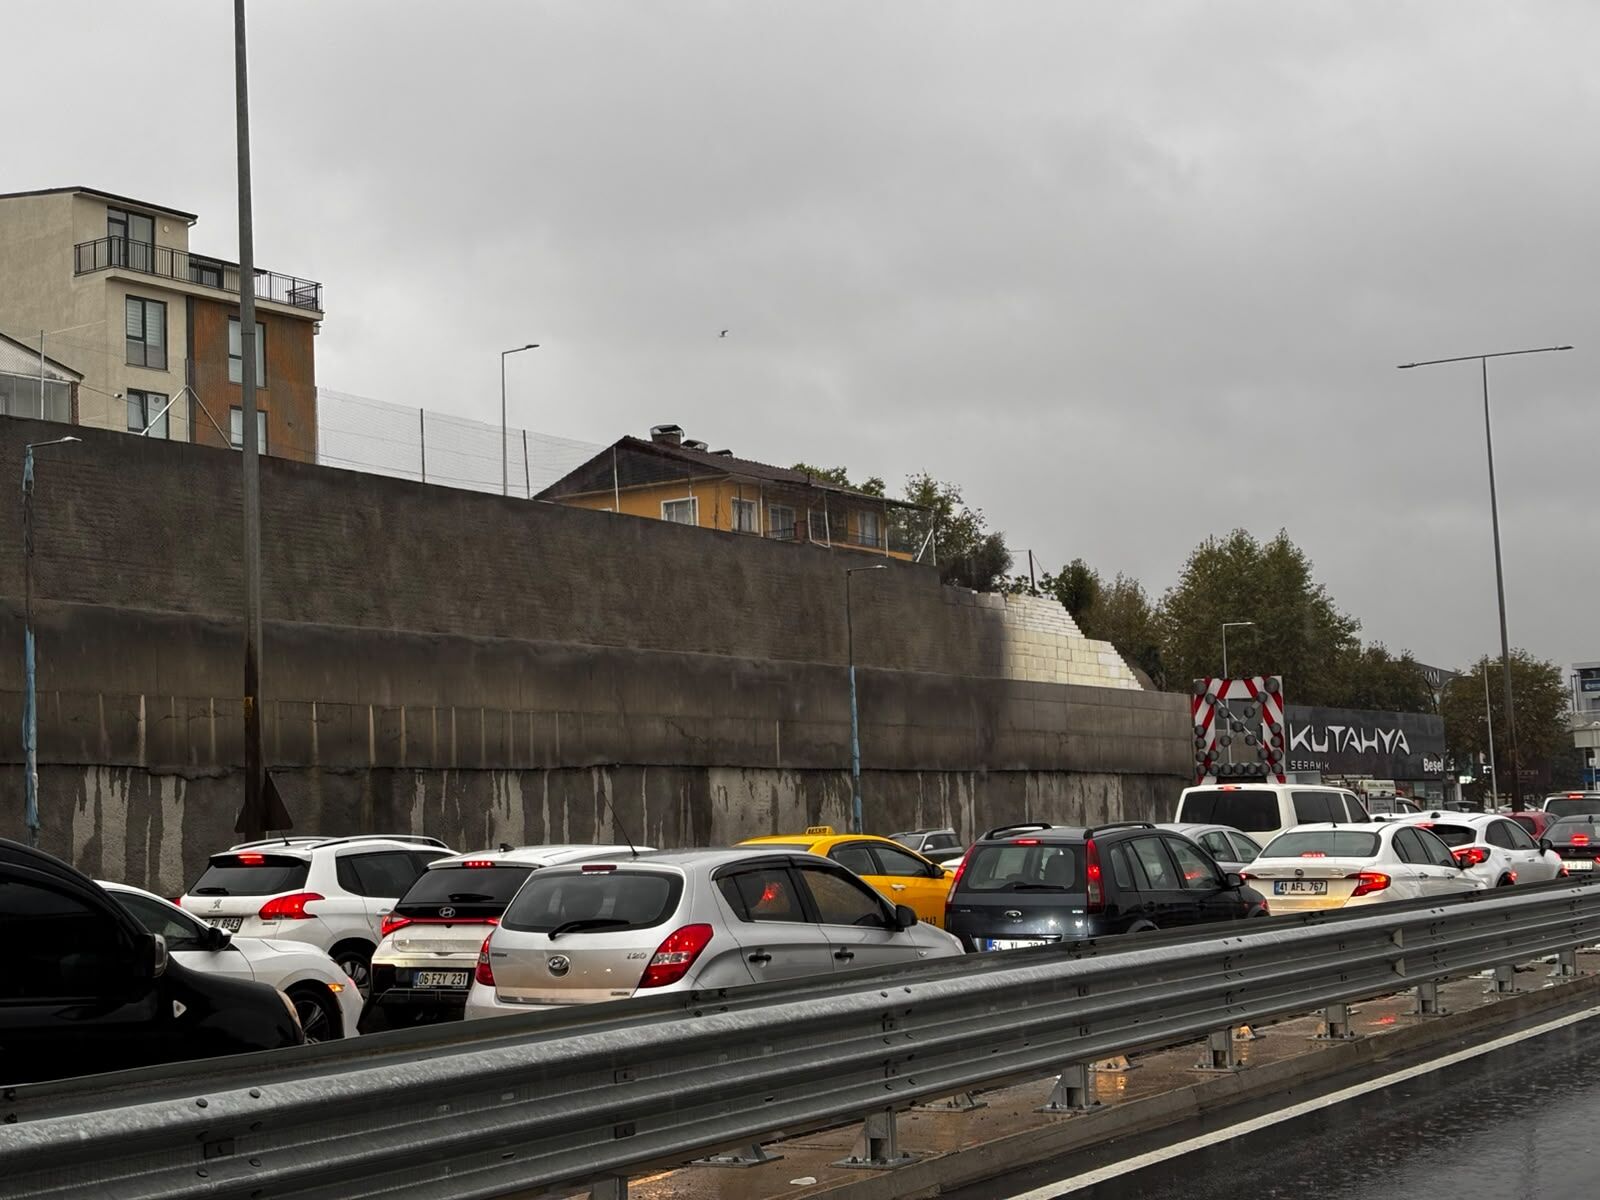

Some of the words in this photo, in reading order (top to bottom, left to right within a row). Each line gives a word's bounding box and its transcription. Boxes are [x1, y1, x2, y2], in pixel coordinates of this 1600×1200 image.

[1279, 882, 1288, 892] 41
[418, 973, 429, 985] 06
[450, 973, 467, 985] 231
